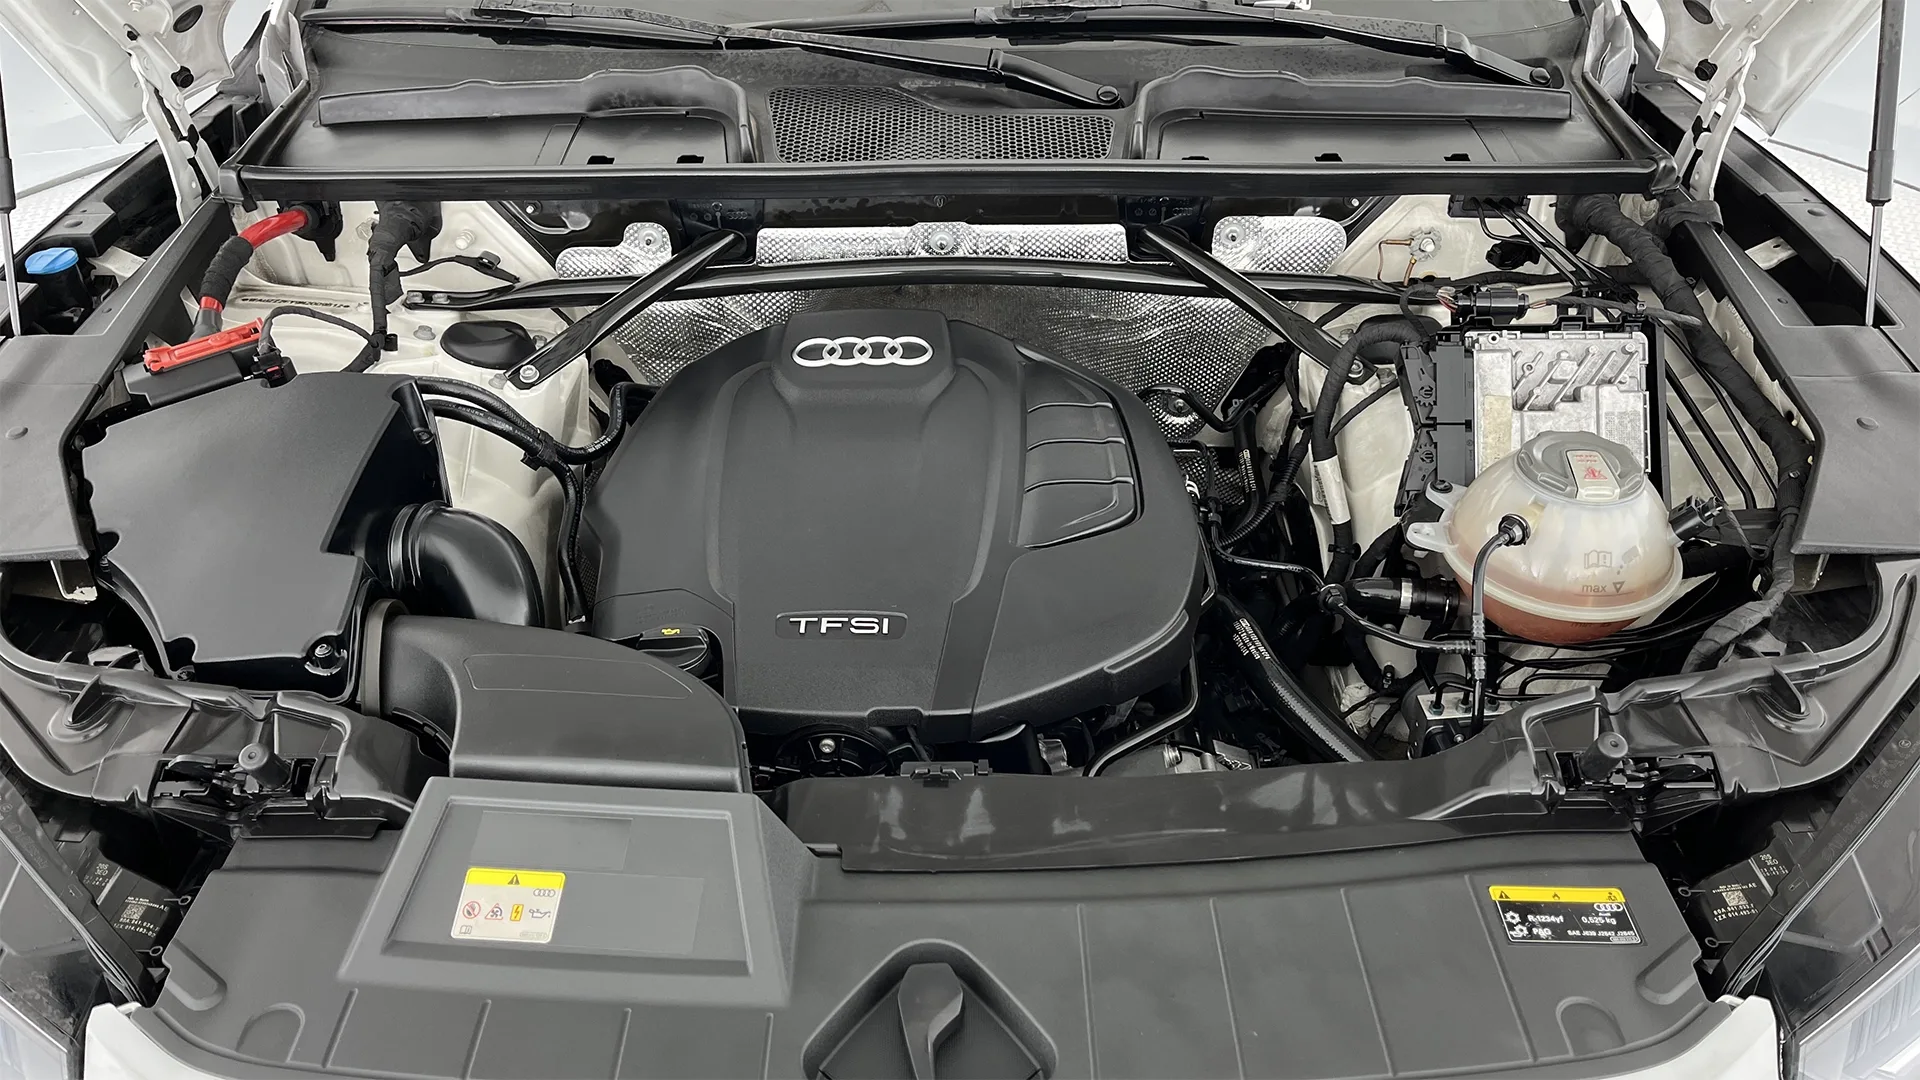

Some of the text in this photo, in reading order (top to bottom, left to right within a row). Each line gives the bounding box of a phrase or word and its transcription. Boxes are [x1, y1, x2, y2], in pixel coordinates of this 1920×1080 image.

[1582, 584, 1607, 593] max
[789, 617, 889, 634] TFSI
[1604, 917, 1617, 925] kg
